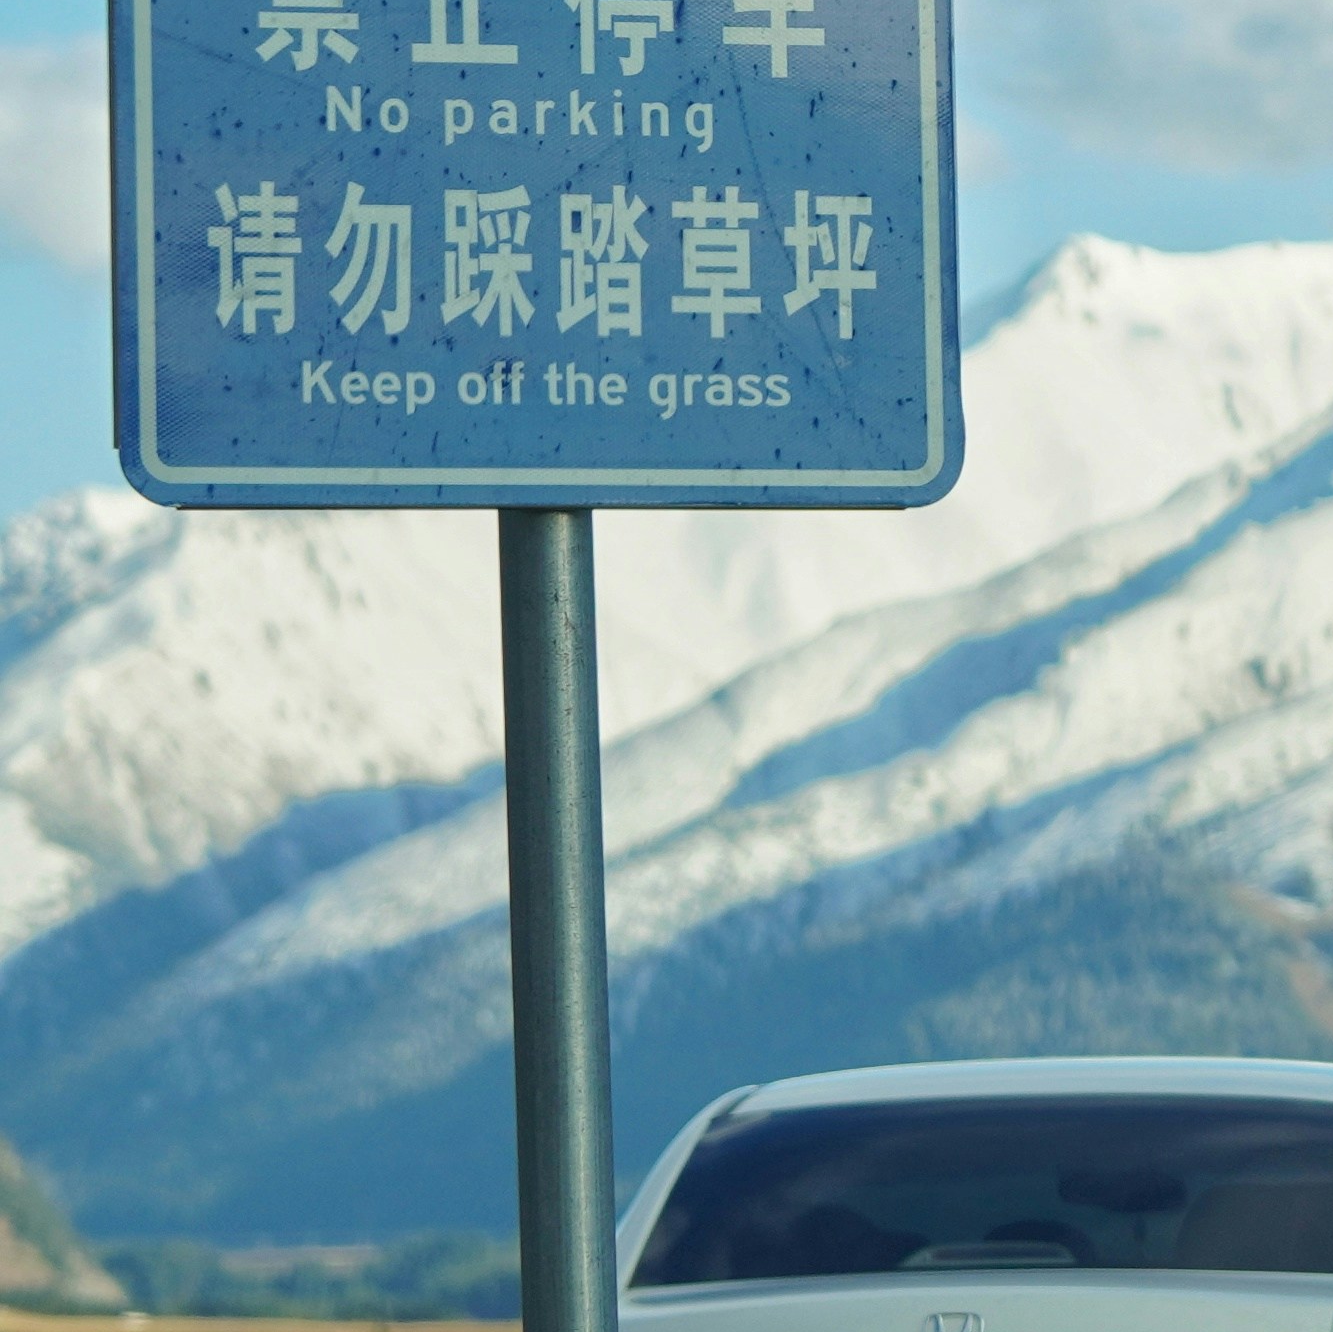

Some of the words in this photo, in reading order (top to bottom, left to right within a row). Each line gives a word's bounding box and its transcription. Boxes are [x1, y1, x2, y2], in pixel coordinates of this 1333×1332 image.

[327, 85, 409, 133] No
[444, 88, 713, 153] parking
[207, 180, 877, 340] 请勿踩踏草坪
[302, 360, 436, 415] Keep
[457, 361, 525, 405] off
[543, 362, 628, 406] the
[648, 373, 792, 420] grass
